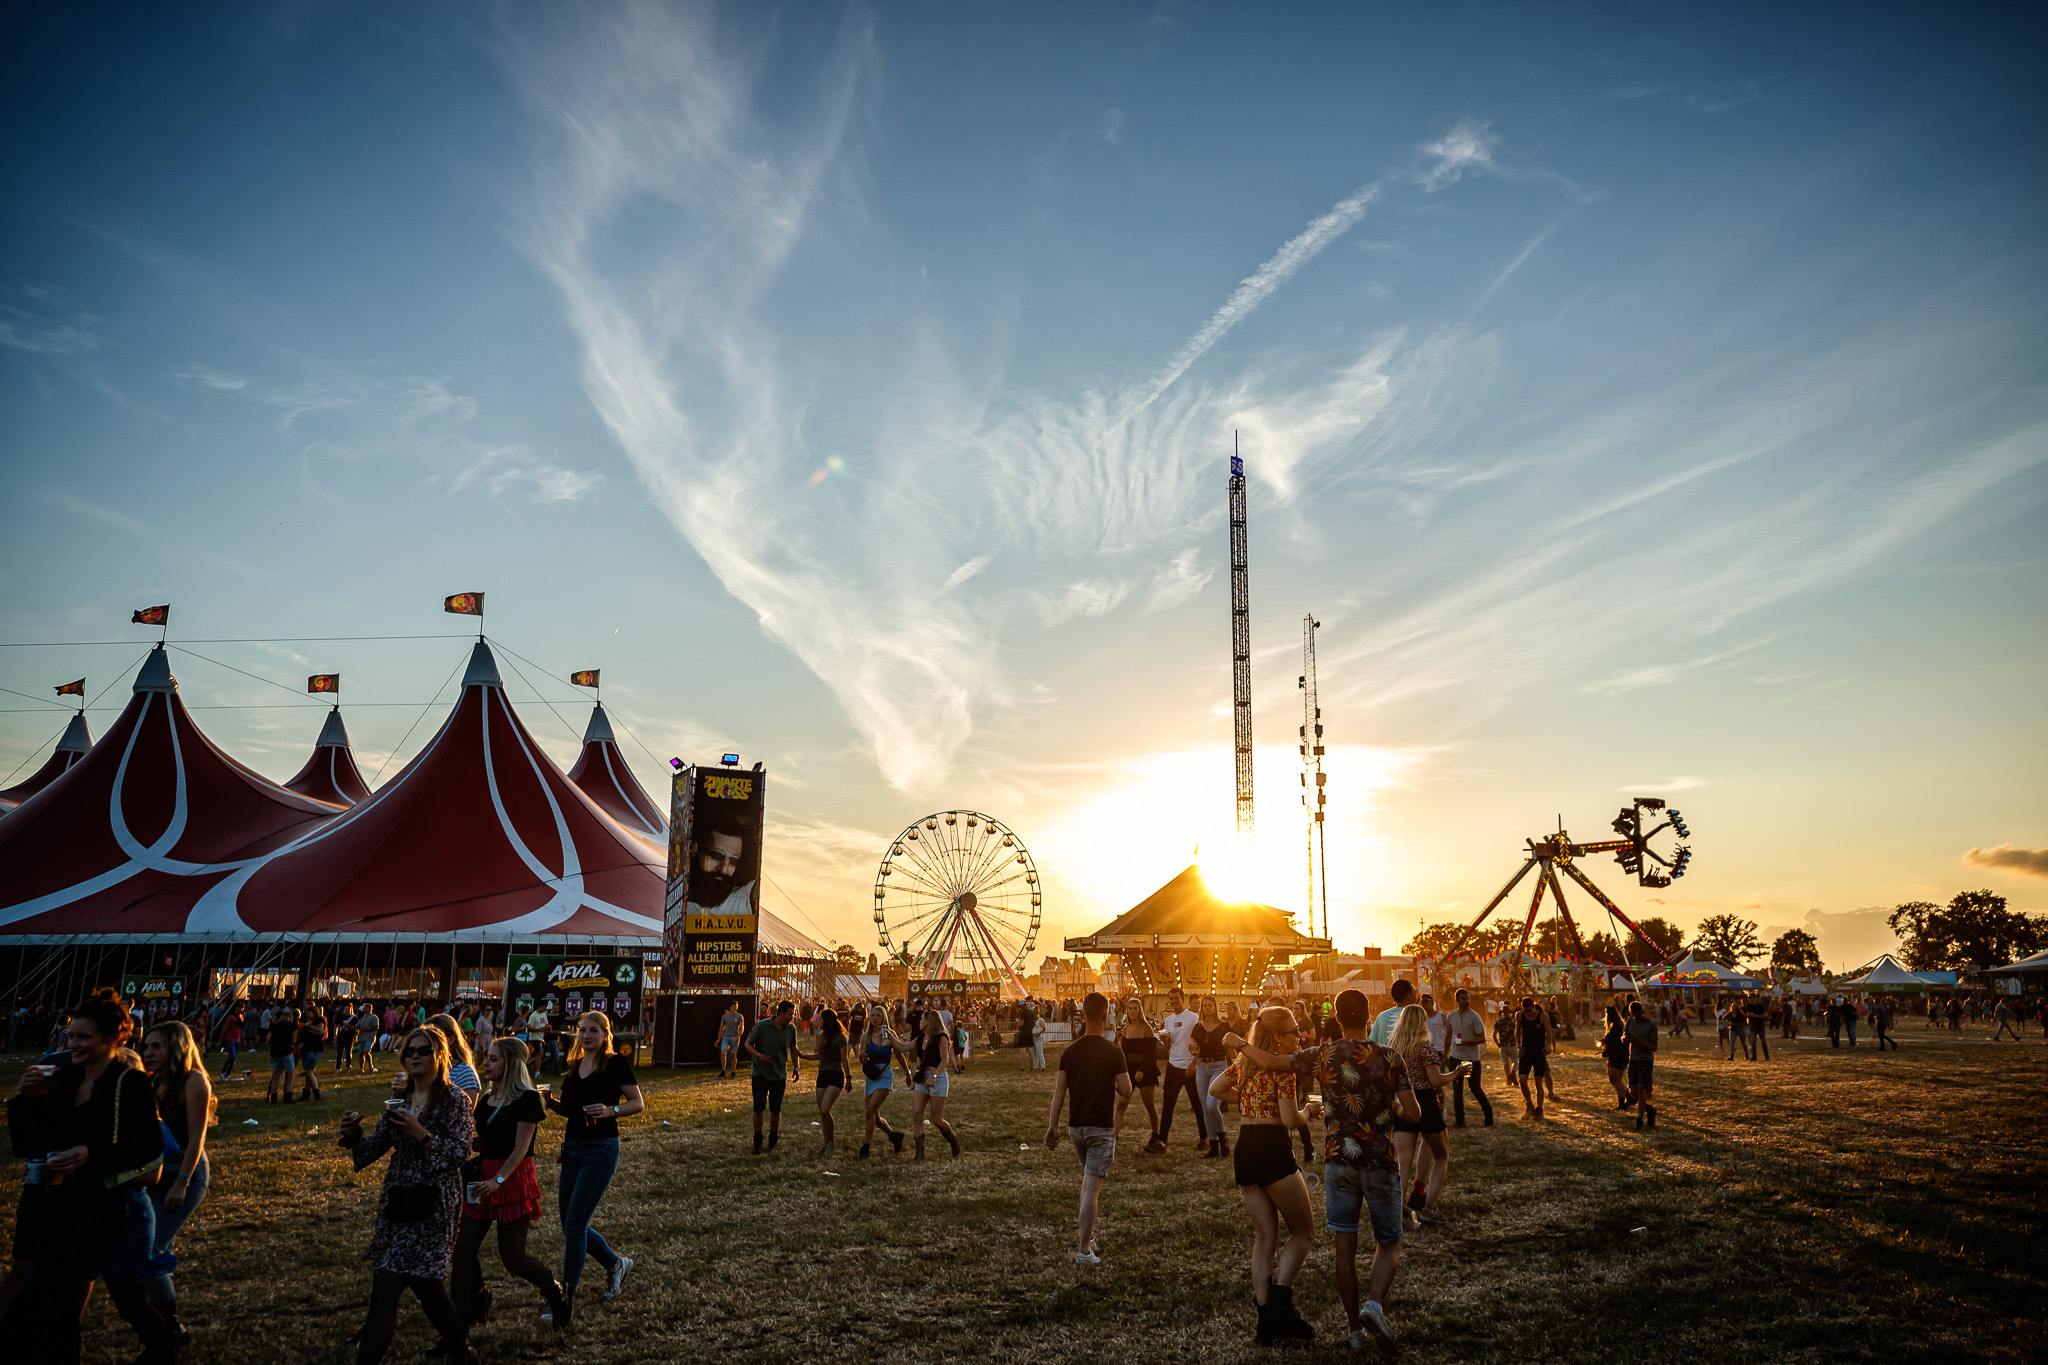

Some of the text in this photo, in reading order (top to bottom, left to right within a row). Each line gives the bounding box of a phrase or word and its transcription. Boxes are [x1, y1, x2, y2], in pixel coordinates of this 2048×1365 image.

[704, 776, 752, 793] ZWARTE
[706, 785, 749, 800] CROSS
[694, 918, 747, 930] H.A.L.V.U.
[696, 941, 742, 952] HIPSTERS
[687, 952, 751, 963] ALLERLANDEN
[547, 963, 601, 982] AFVAL
[691, 964, 747, 975] VERENIGT U!
[141, 981, 167, 993] AFVAL
[924, 983, 949, 992] AFVAL
